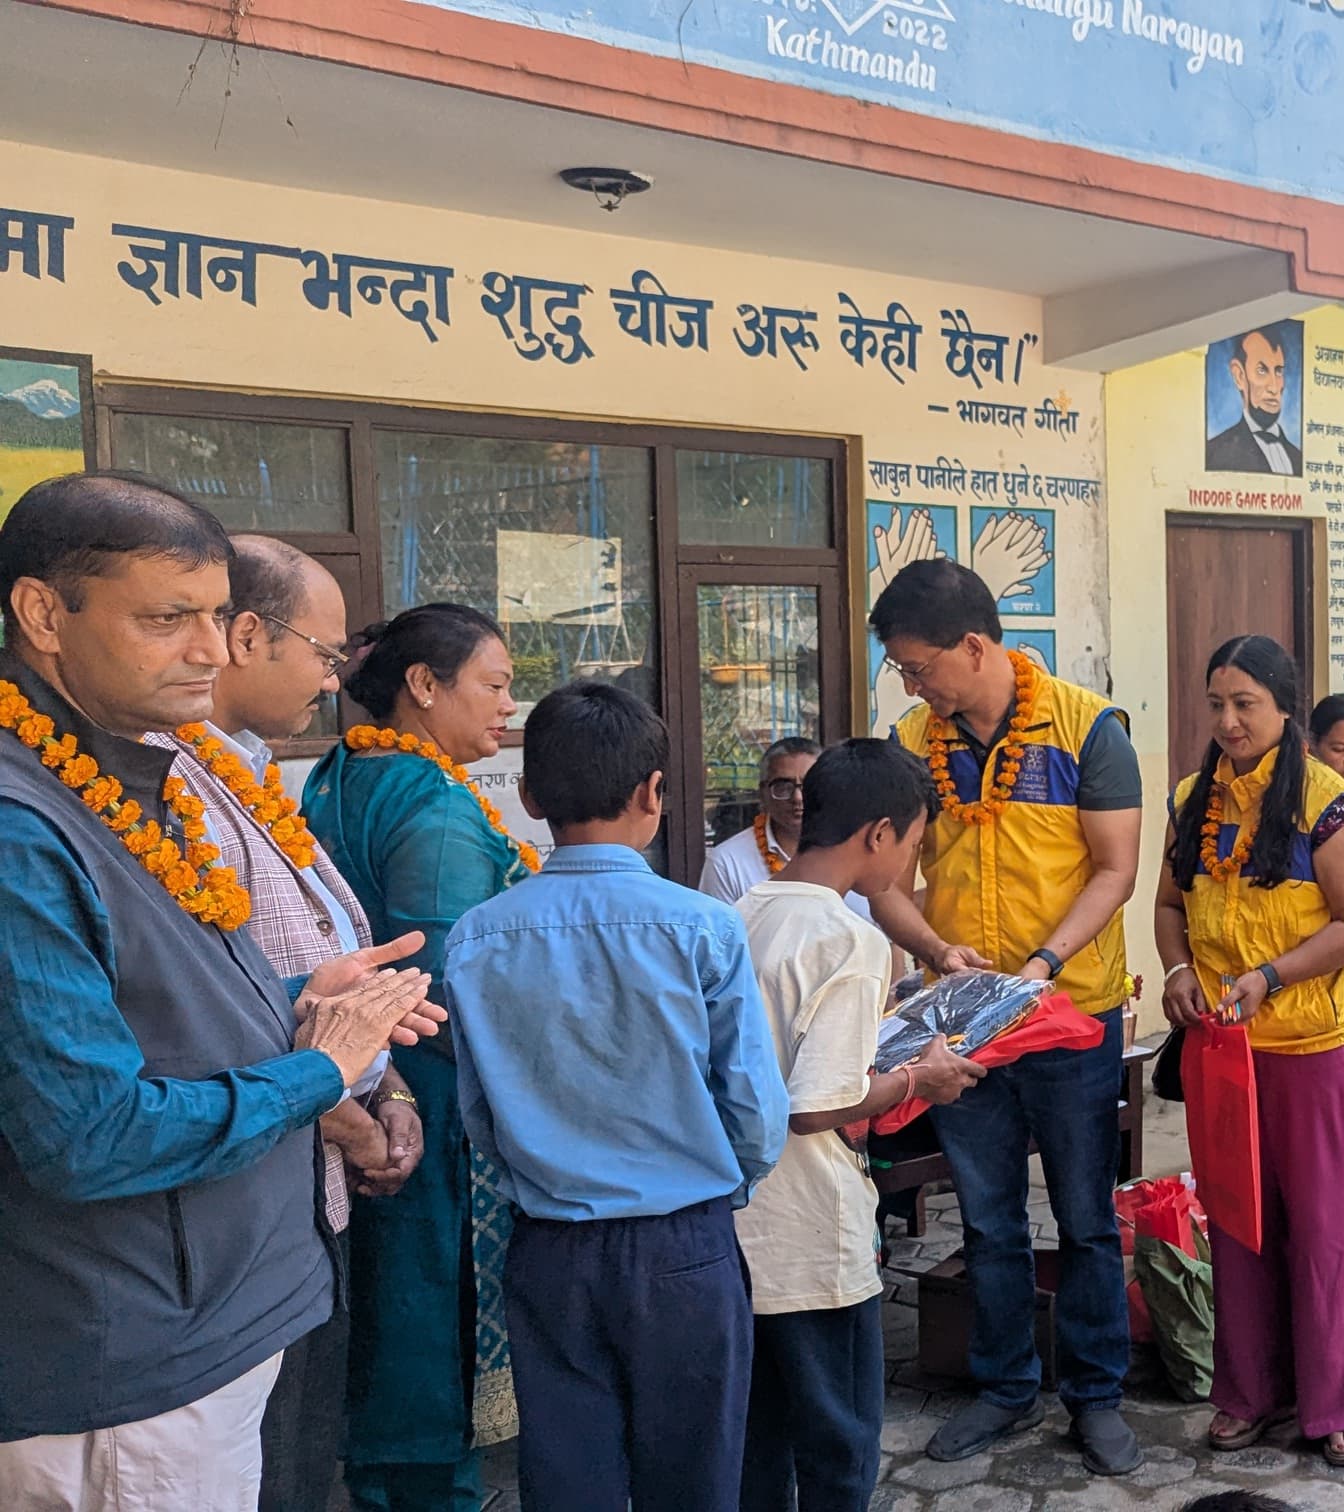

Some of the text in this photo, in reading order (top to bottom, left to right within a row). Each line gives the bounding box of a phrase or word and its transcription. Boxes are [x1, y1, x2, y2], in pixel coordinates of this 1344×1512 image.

[766, 15, 937, 92] Kathmandu
[882, 10, 948, 50] 2022
[1122, 0, 1244, 74] Narayan
[112, 223, 300, 307] ज्ञान
[299, 249, 454, 343] भन्दा
[610, 269, 713, 352] चीज
[838, 292, 922, 385] केही
[1034, 397, 1079, 442] गीता
[868, 460, 911, 497] साबुन
[916, 455, 967, 495] पानीले
[970, 469, 999, 501] हात
[1003, 463, 1031, 506] धुने
[1188, 489, 1232, 507] INDOOR
[1235, 491, 1268, 509] GAME
[1270, 493, 1302, 510] ROOM
